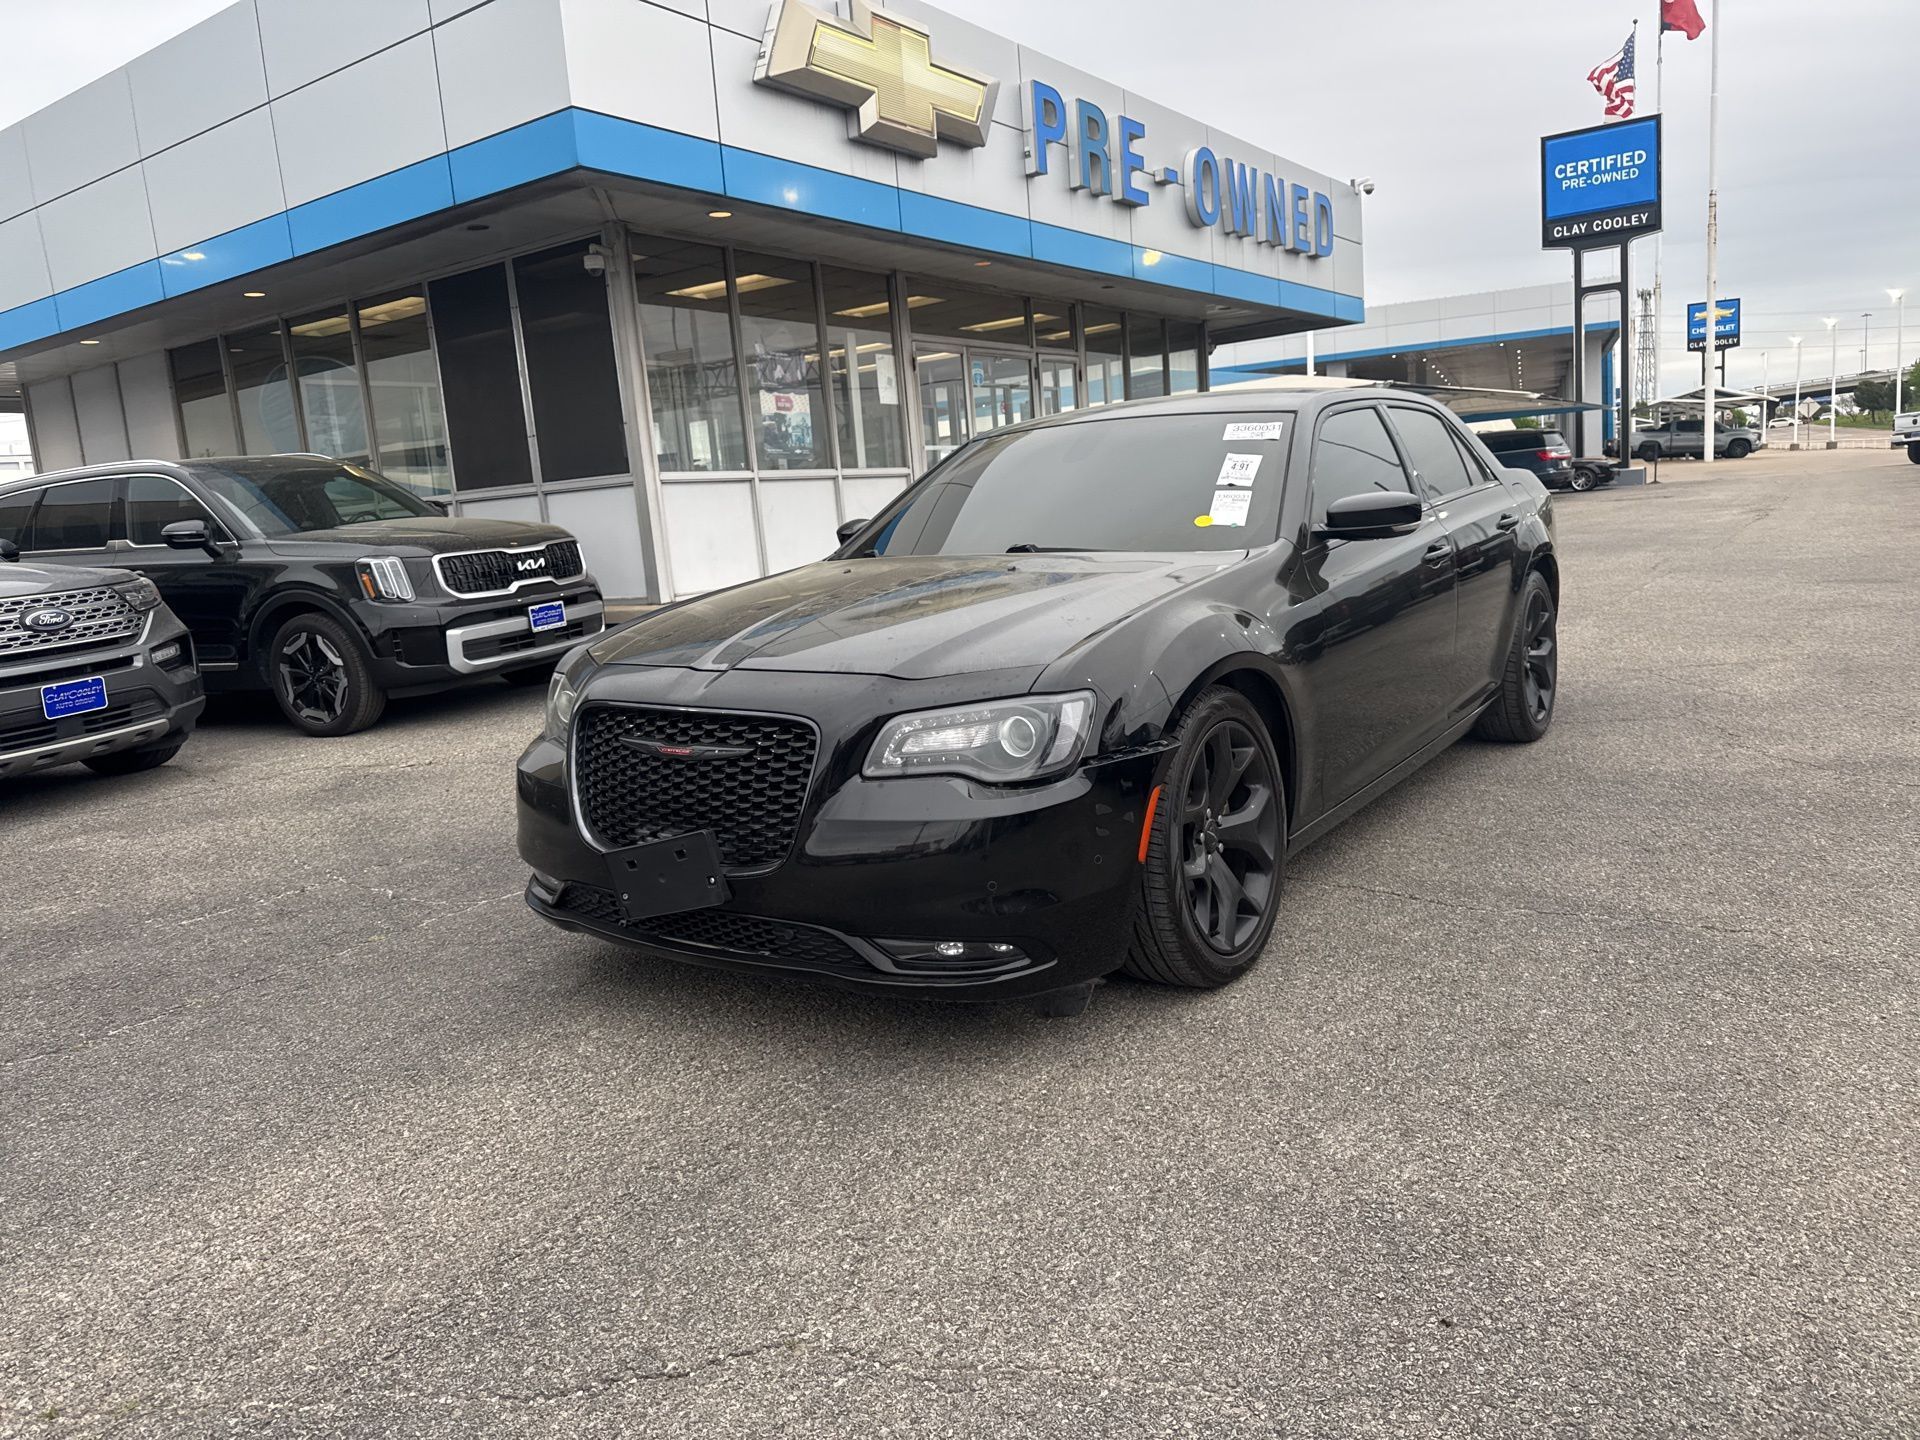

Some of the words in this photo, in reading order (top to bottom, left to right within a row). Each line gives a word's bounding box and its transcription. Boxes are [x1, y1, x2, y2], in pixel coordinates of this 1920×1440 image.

[1019, 79, 1334, 259] PRE-OWNED
[1554, 150, 1647, 179] CERTIFIED
[1562, 168, 1639, 191] PRE-OWNED
[1553, 222, 1588, 238] CLAY
[1592, 212, 1649, 232] COOLEY
[1689, 341, 1707, 349] CLAY
[1714, 337, 1738, 346] OOLEY
[39, 613, 64, 625] Ford
[55, 701, 74, 710] AUTO
